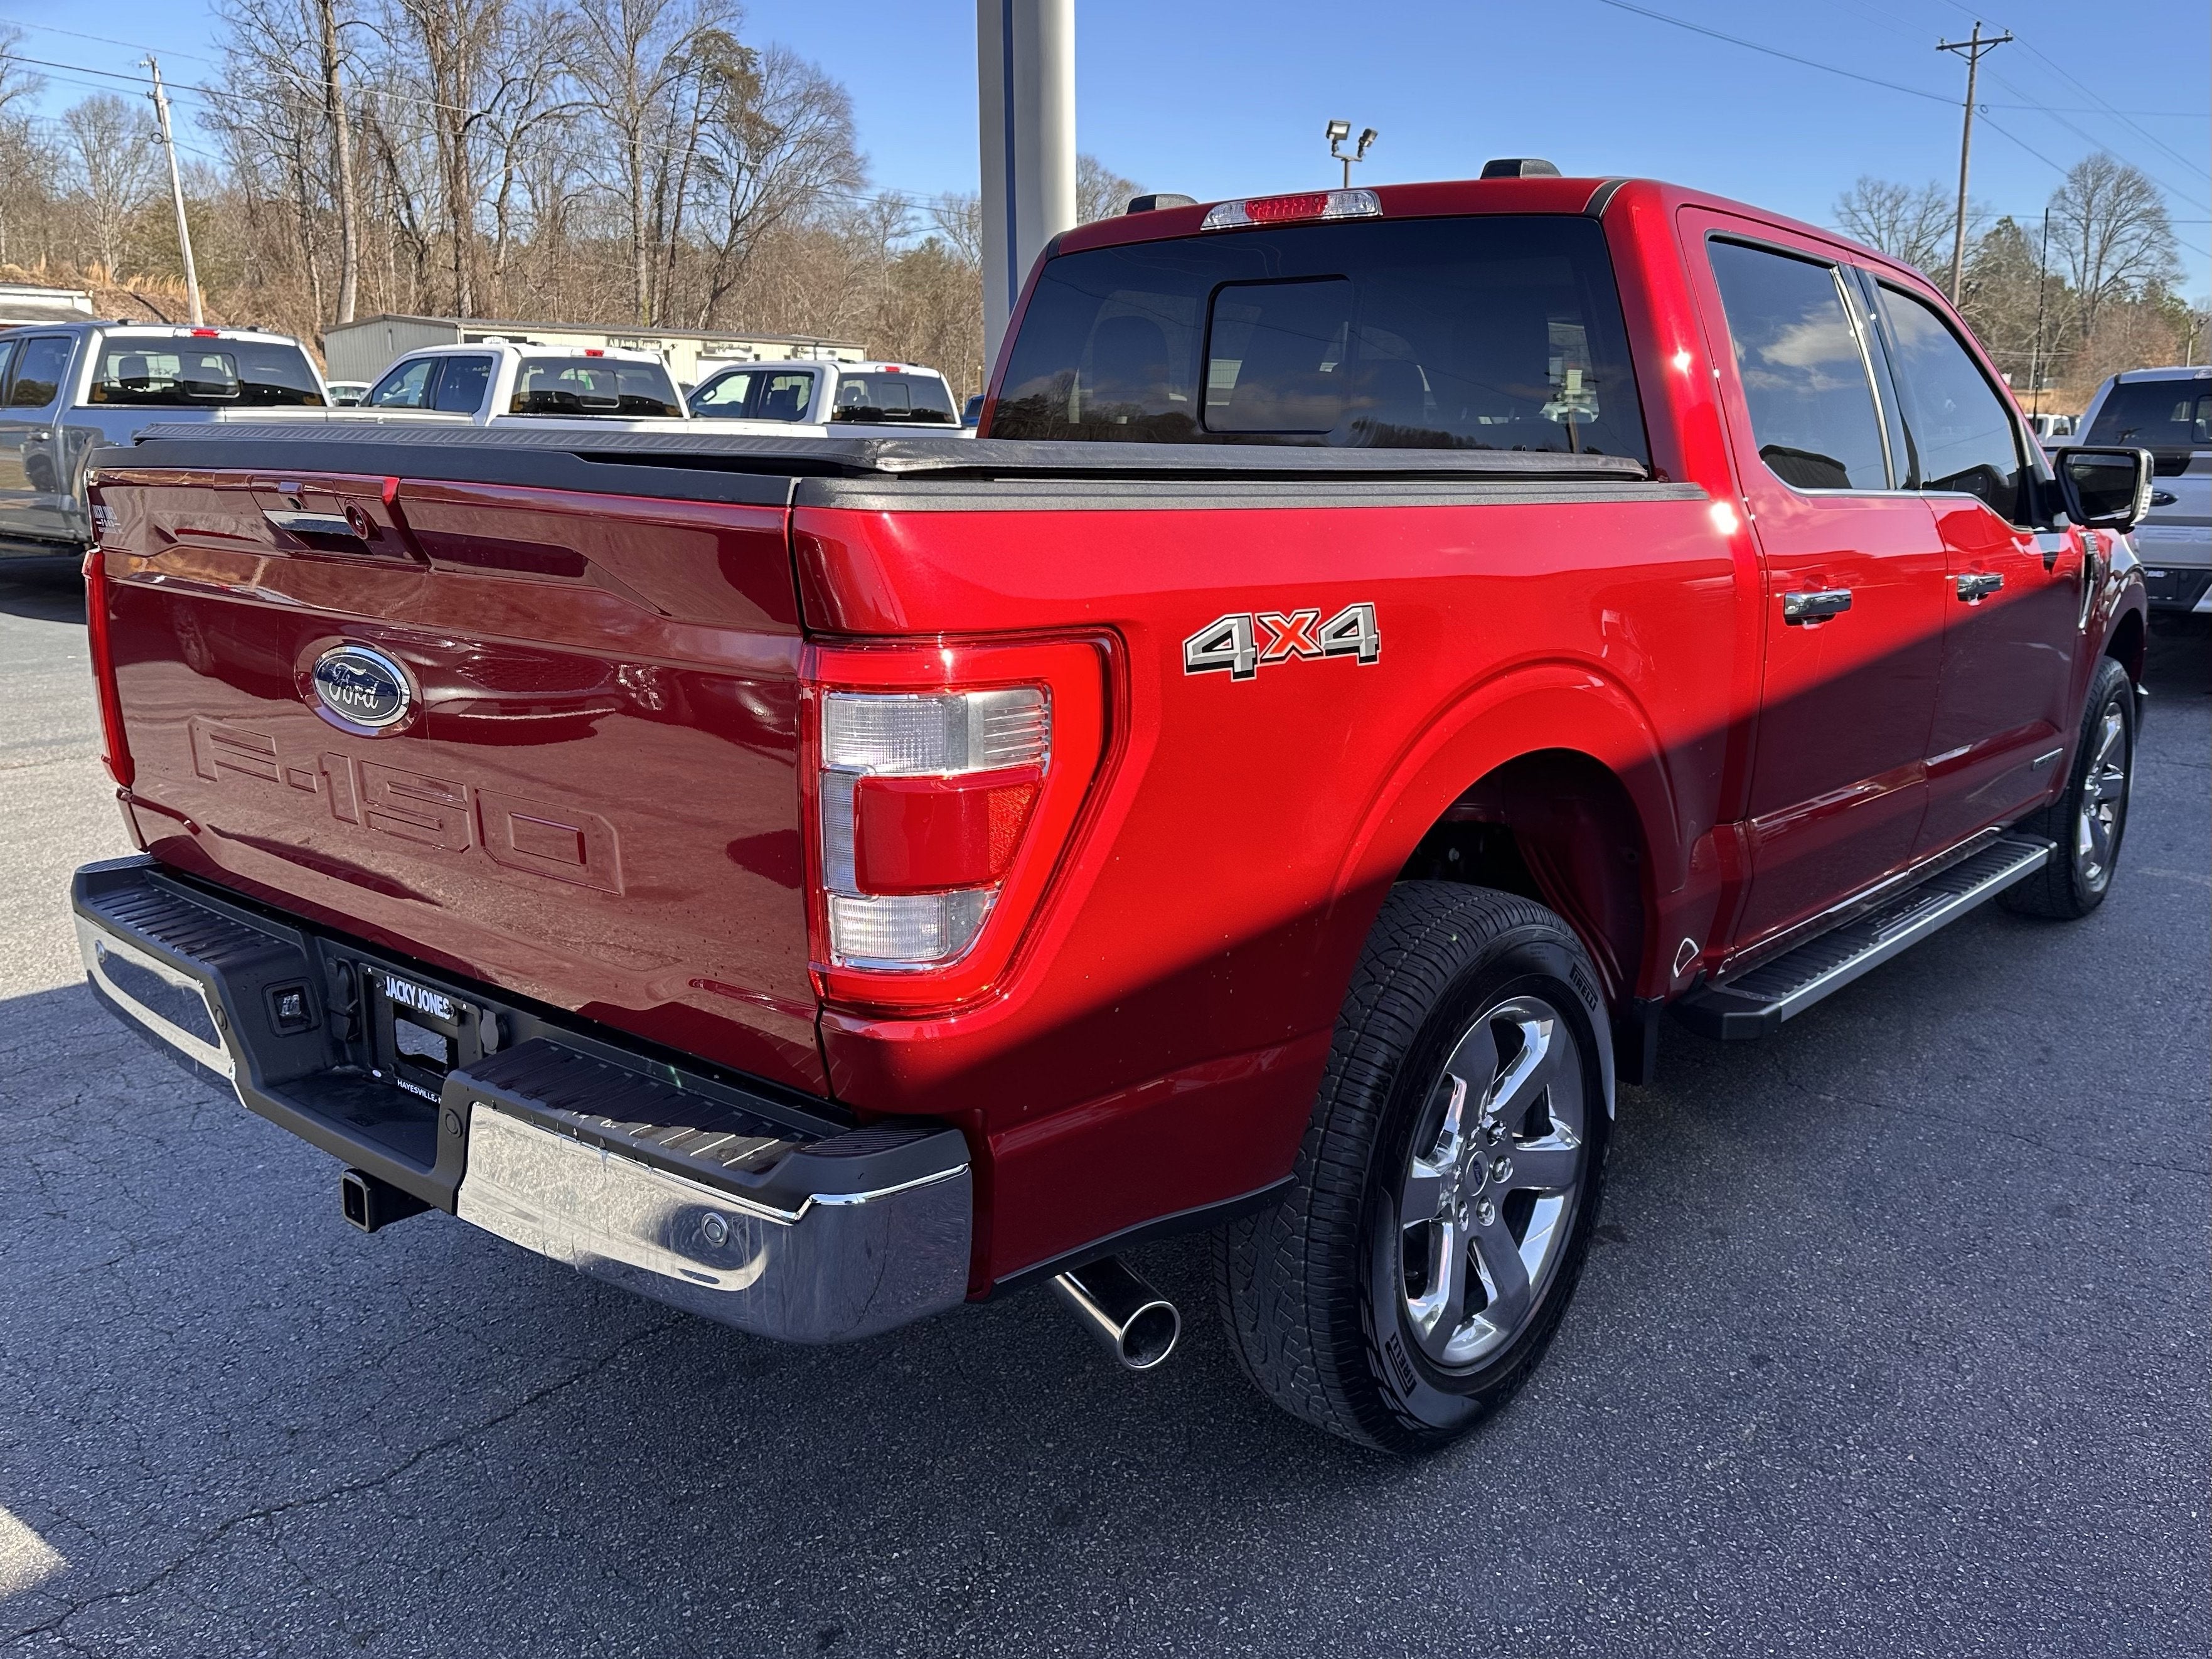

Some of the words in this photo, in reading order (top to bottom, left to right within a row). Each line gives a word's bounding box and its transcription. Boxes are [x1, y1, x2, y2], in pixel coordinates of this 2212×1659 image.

[620, 339, 637, 348] Auto
[328, 662, 380, 710] Ford
[189, 715, 625, 896] F-150
[385, 976, 416, 1006] JACKY
[417, 988, 451, 1020] JONES
[1569, 963, 1598, 1012] PIRELLI
[397, 1079, 437, 1103] HAYESVILLE,
[1384, 1331, 1417, 1399] PIRELLI
